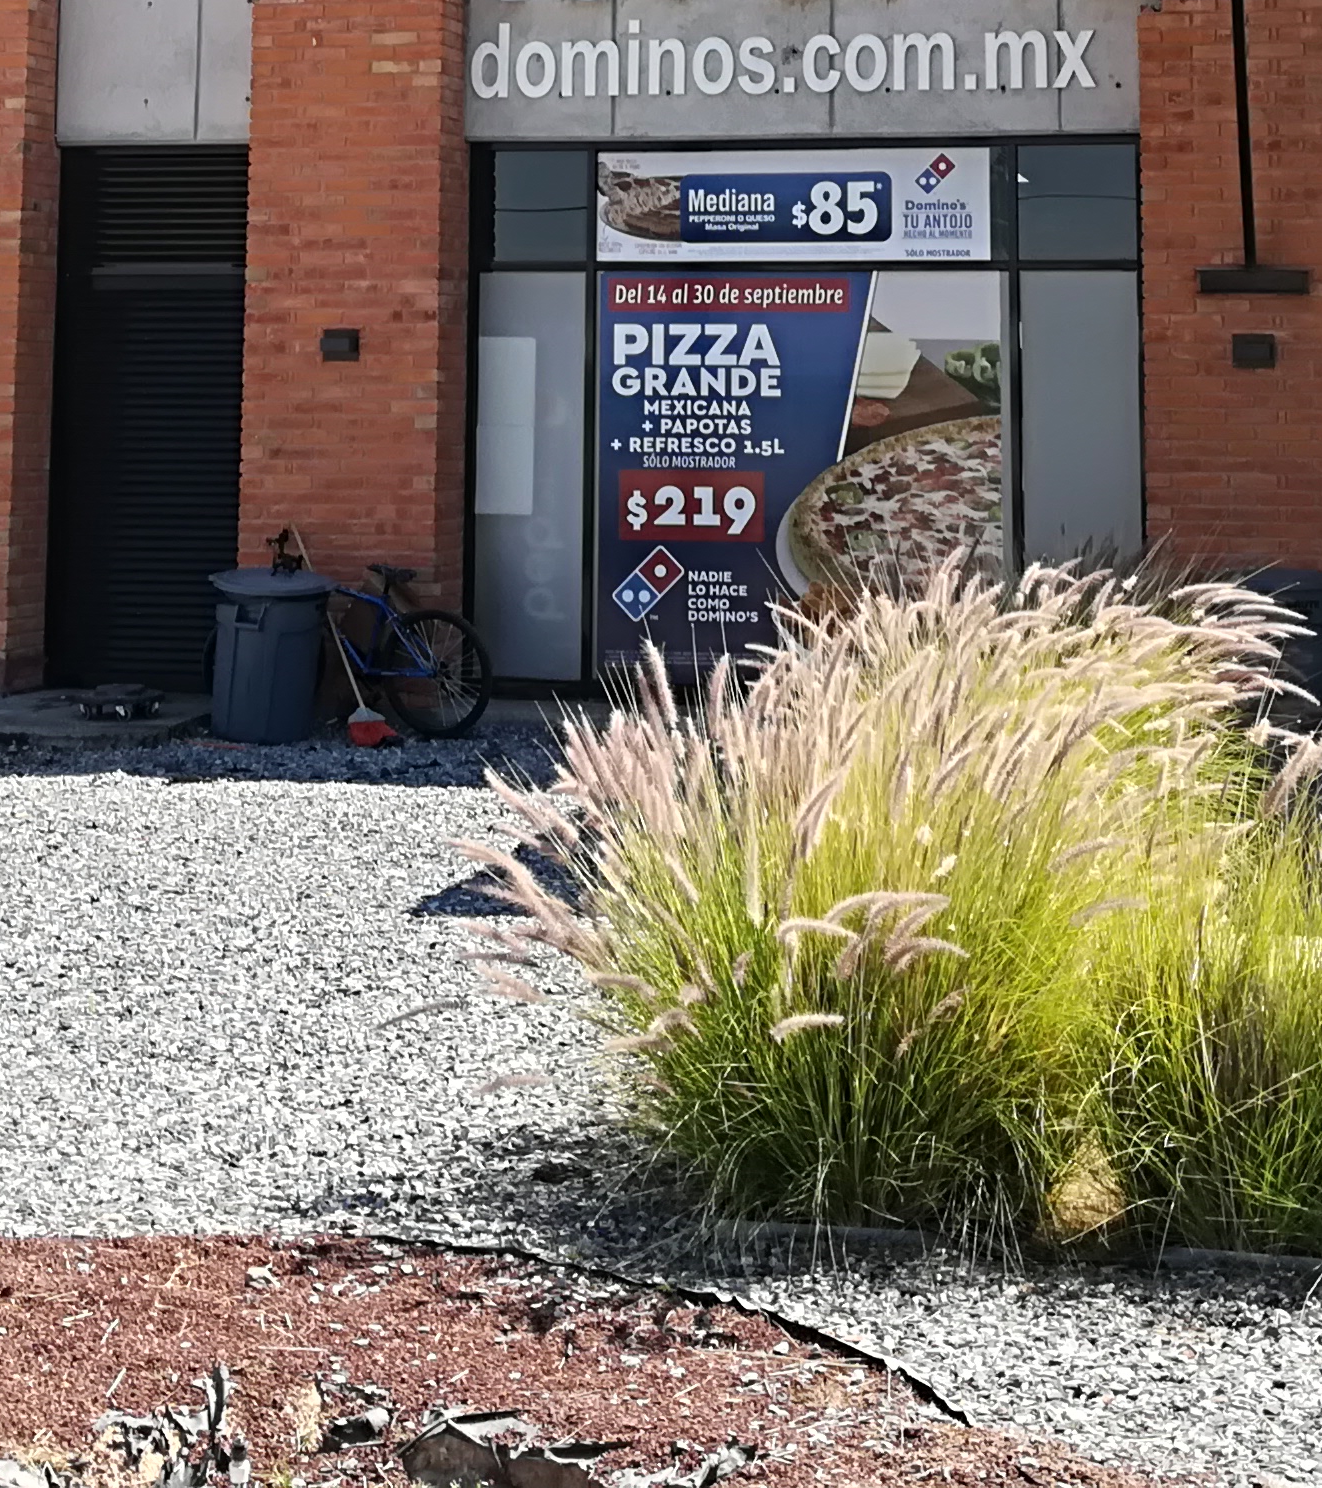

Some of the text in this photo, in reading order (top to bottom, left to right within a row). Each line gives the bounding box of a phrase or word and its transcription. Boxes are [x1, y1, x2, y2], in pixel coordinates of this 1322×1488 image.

[470, 19, 1097, 100] dominos.com.mx
[687, 188, 775, 213] Mediana
[791, 179, 879, 236] $85
[904, 198, 967, 211] Domino's
[688, 214, 736, 223] PEPPERONI
[746, 214, 775, 224] QUESO
[903, 214, 973, 229] TU ANTOJO
[705, 223, 759, 232] Masa Original
[926, 248, 971, 258] MOSTRADOR
[615, 283, 844, 308] Del 14 al 30 de septiembre
[613, 323, 781, 366] PIZZA
[611, 367, 782, 397] GRANDE
[643, 400, 752, 416] MEXICANA
[660, 418, 752, 435] PAPOTAS
[629, 437, 736, 453] REFRESCO
[743, 438, 785, 457] 1.5L
[672, 455, 736, 469] MOSTRADOR
[626, 485, 756, 535] $219
[688, 570, 733, 582] NADIE
[688, 584, 748, 597] LO HACE
[687, 598, 730, 609] COMO
[687, 611, 759, 623] DOMINO'S
